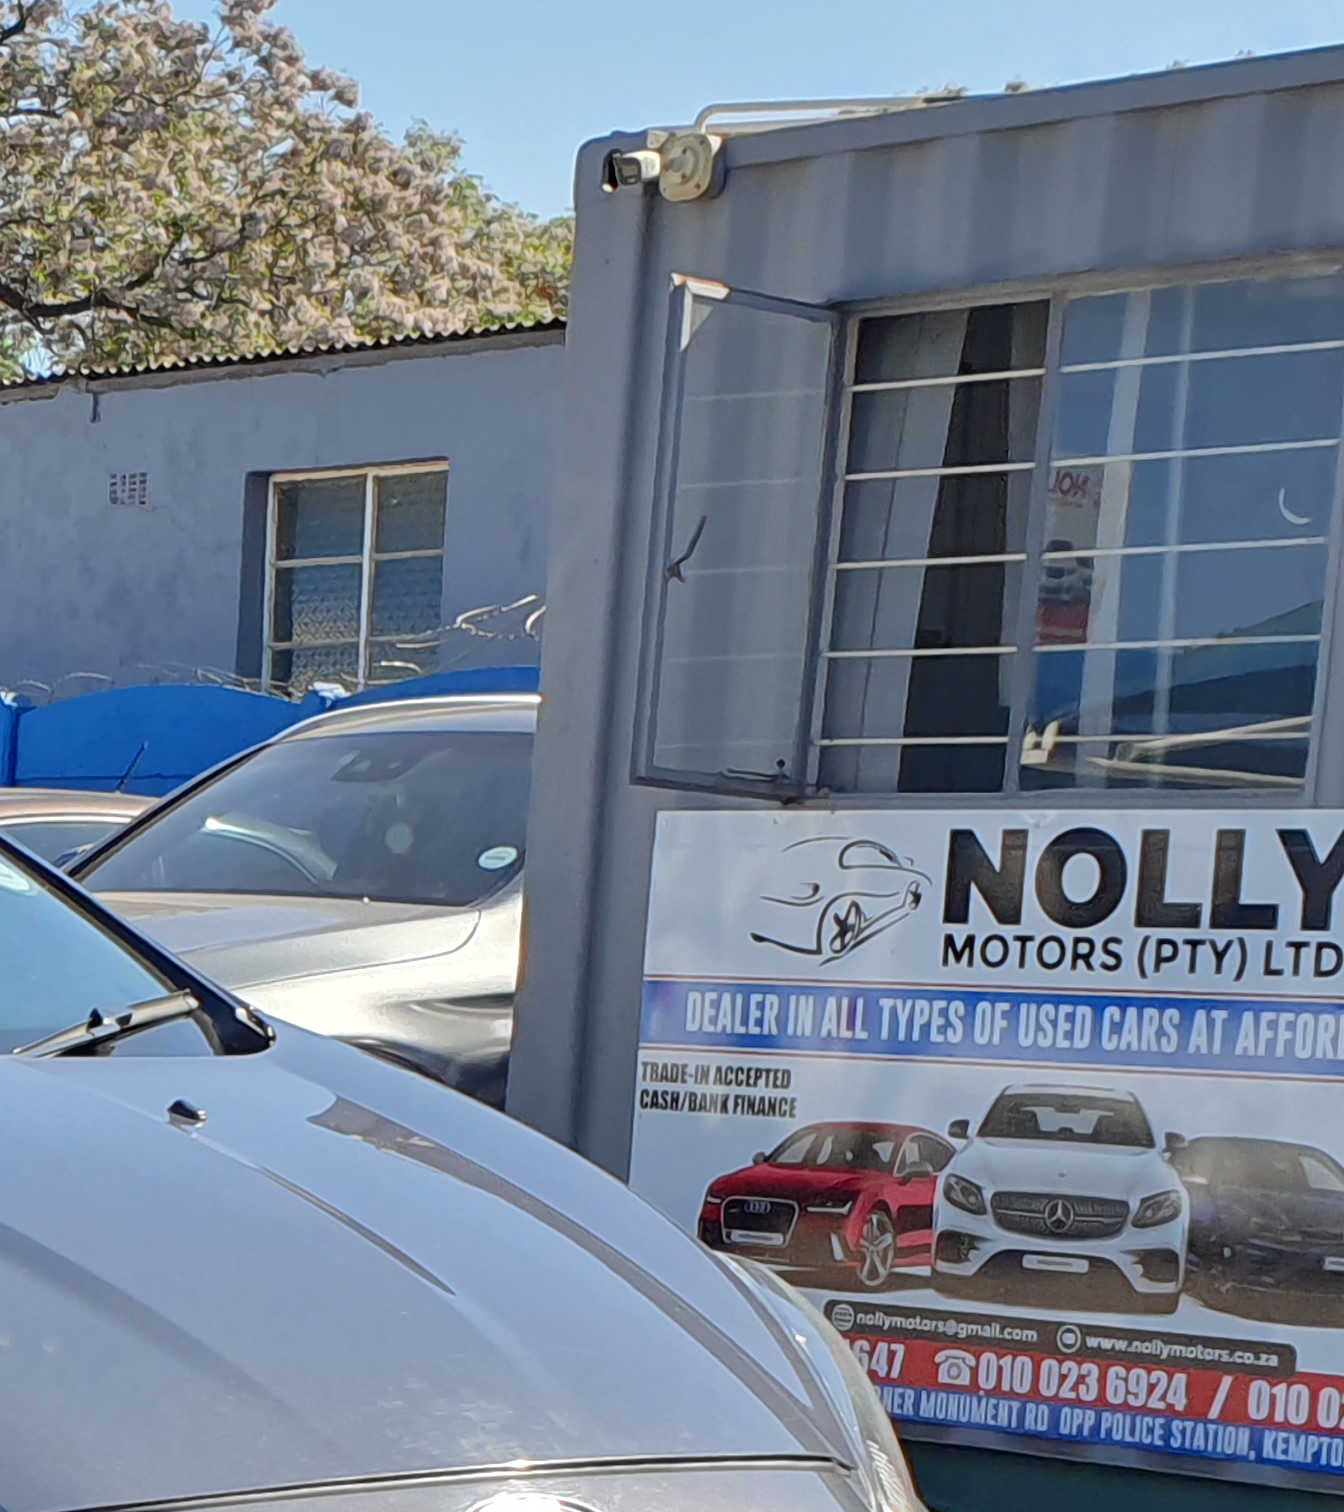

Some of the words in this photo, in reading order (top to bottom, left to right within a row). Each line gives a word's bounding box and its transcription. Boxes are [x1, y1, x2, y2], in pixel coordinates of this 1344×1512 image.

[942, 826, 1344, 931] NOLLY
[942, 932, 1123, 972] MOTORS
[1136, 935, 1248, 982] (PTY)
[1263, 940, 1344, 979] LTD
[685, 991, 779, 1037] DEALER
[787, 994, 813, 1038] IN
[820, 995, 869, 1040] ALL
[879, 997, 964, 1045] TYPES
[973, 1000, 1011, 1046] OF
[1018, 1002, 1092, 1049] USED
[1101, 1005, 1179, 1053] CARS
[1188, 1009, 1228, 1056] AT
[639, 1088, 730, 1115] CASH/BANK
[733, 1094, 797, 1119] FINANCE
[641, 1061, 710, 1087] TRADE-IN
[713, 1065, 791, 1090] ACCEPTED
[856, 1311, 1039, 1342] nollymotors@gmail.com
[1085, 1334, 1280, 1368] www.nollymotors.co.za
[844, 1338, 905, 1379] 647
[977, 1352, 1033, 1395] 010
[1039, 1358, 1099, 1401] 023
[1105, 1366, 1189, 1413] 6924
[1248, 1379, 1310, 1426] 010
[1317, 1386, 1344, 1431] 0
[919, 1390, 1019, 1429] MONUMENT
[1024, 1401, 1050, 1432] RD
[1059, 1406, 1096, 1437] OPP
[1100, 1412, 1166, 1446] POLICE
[1170, 1419, 1255, 1461] STATION,
[1263, 1429, 1344, 1468] KEMPTO
